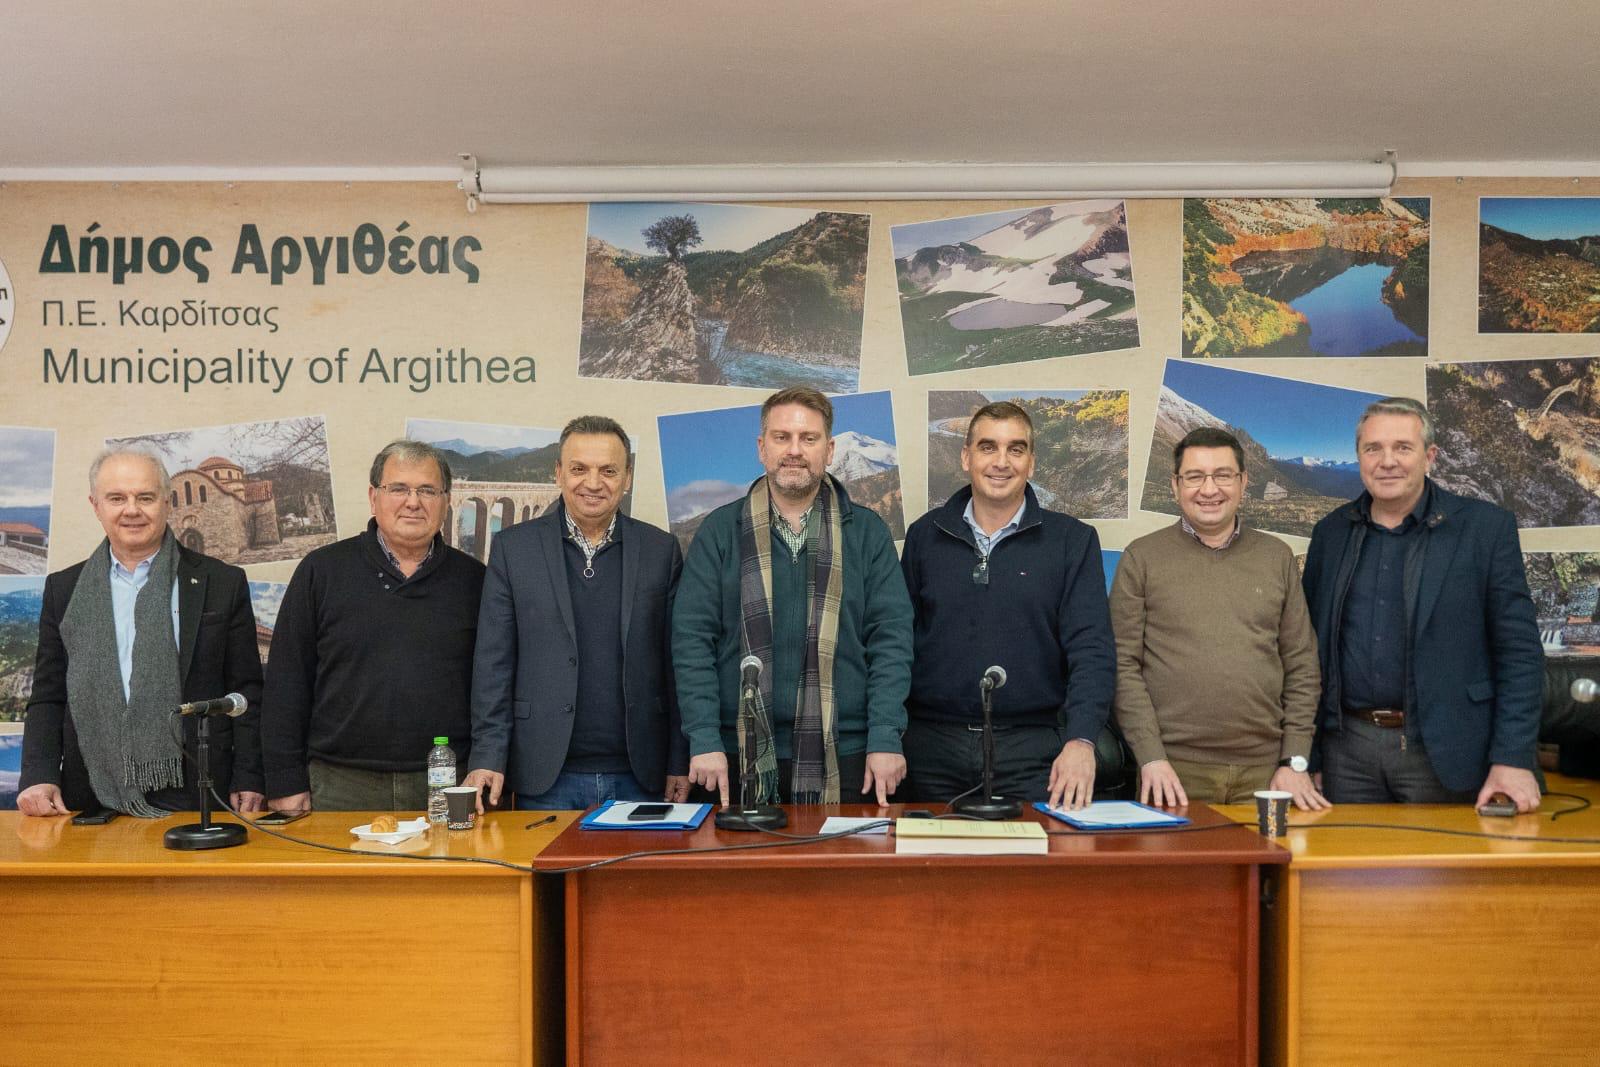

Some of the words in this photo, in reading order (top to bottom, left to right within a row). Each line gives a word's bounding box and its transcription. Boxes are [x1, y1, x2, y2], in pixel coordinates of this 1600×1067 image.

[38, 222, 213, 285] Δήμος
[231, 220, 483, 285] Αργιθέας
[43, 300, 107, 327] Π.Ε.
[119, 300, 279, 333] Καρδίτσας
[43, 348, 294, 394] Municipality
[308, 348, 350, 384] of
[359, 348, 537, 393] Argithea
